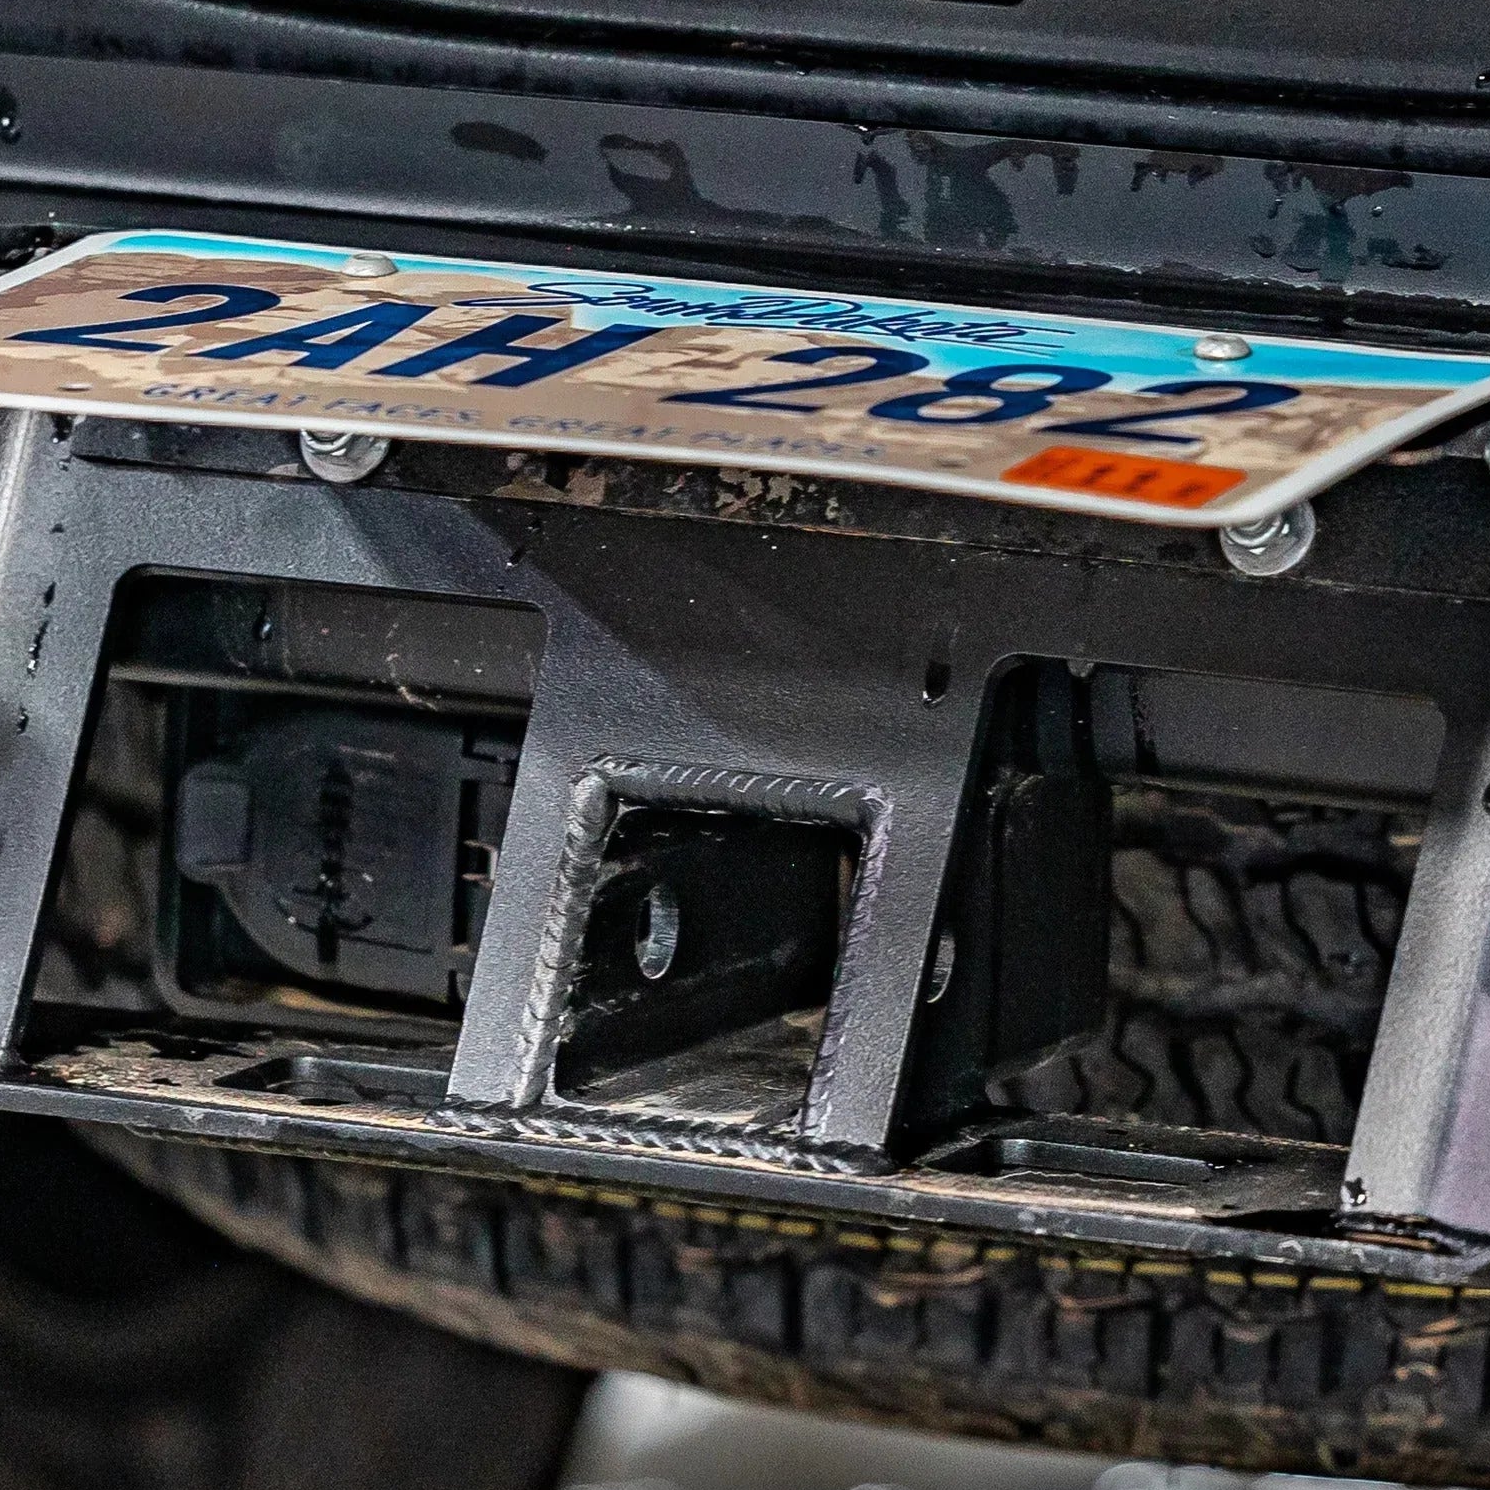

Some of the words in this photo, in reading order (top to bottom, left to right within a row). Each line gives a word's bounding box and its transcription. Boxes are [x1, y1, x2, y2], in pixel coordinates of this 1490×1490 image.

[706, 294, 1076, 357] Dakota
[0, 282, 674, 389] 2AH
[658, 345, 1303, 445] 282
[142, 382, 314, 411] GREAT
